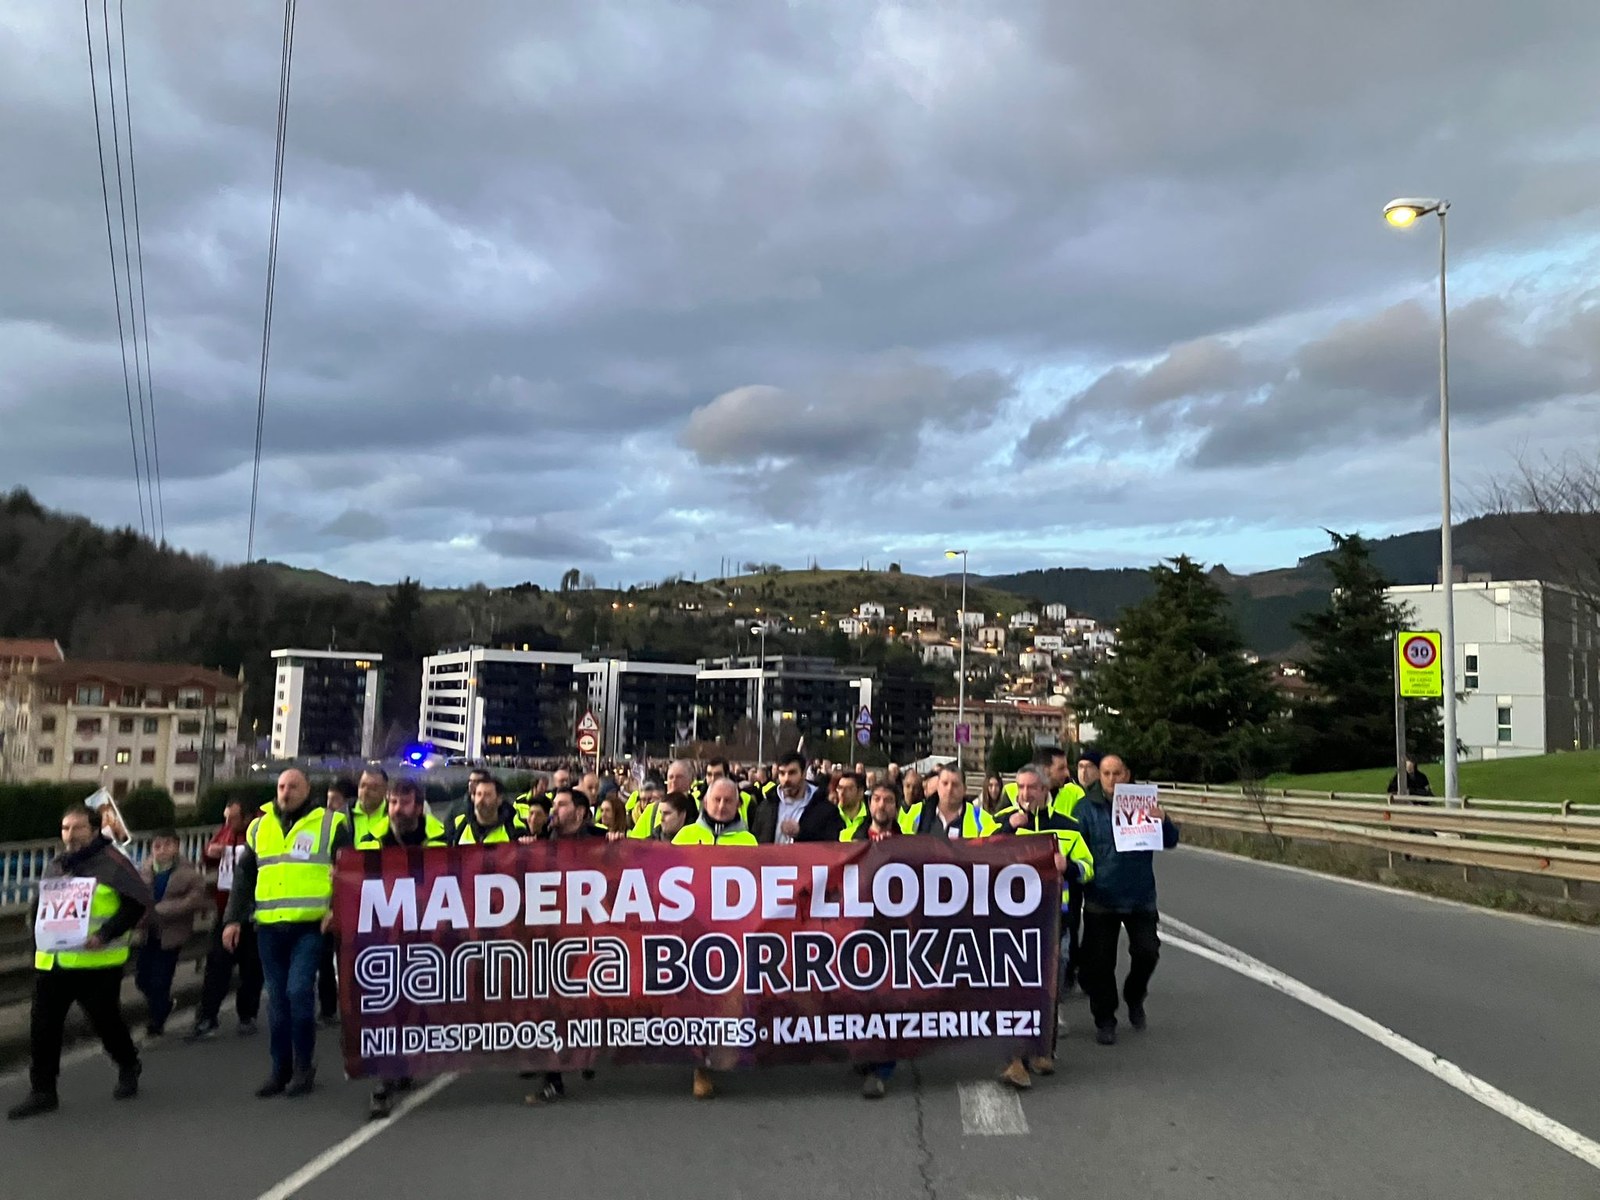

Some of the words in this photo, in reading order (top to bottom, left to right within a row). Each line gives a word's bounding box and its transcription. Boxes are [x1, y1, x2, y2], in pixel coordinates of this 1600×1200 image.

[1410, 646, 1430, 659] 30
[357, 866, 696, 934] MADERAS
[710, 865, 798, 920] DE
[809, 863, 1043, 918] LLODIO
[354, 936, 630, 1014] garnica
[641, 928, 1043, 995] BORROKAN
[361, 1026, 396, 1058] NI
[402, 1021, 564, 1053] DESPIDOS,
[567, 1019, 602, 1047] NI
[607, 1016, 757, 1047] RECORTES
[773, 1010, 992, 1044] KALERATZERIK
[996, 1010, 1042, 1037] EZ!
